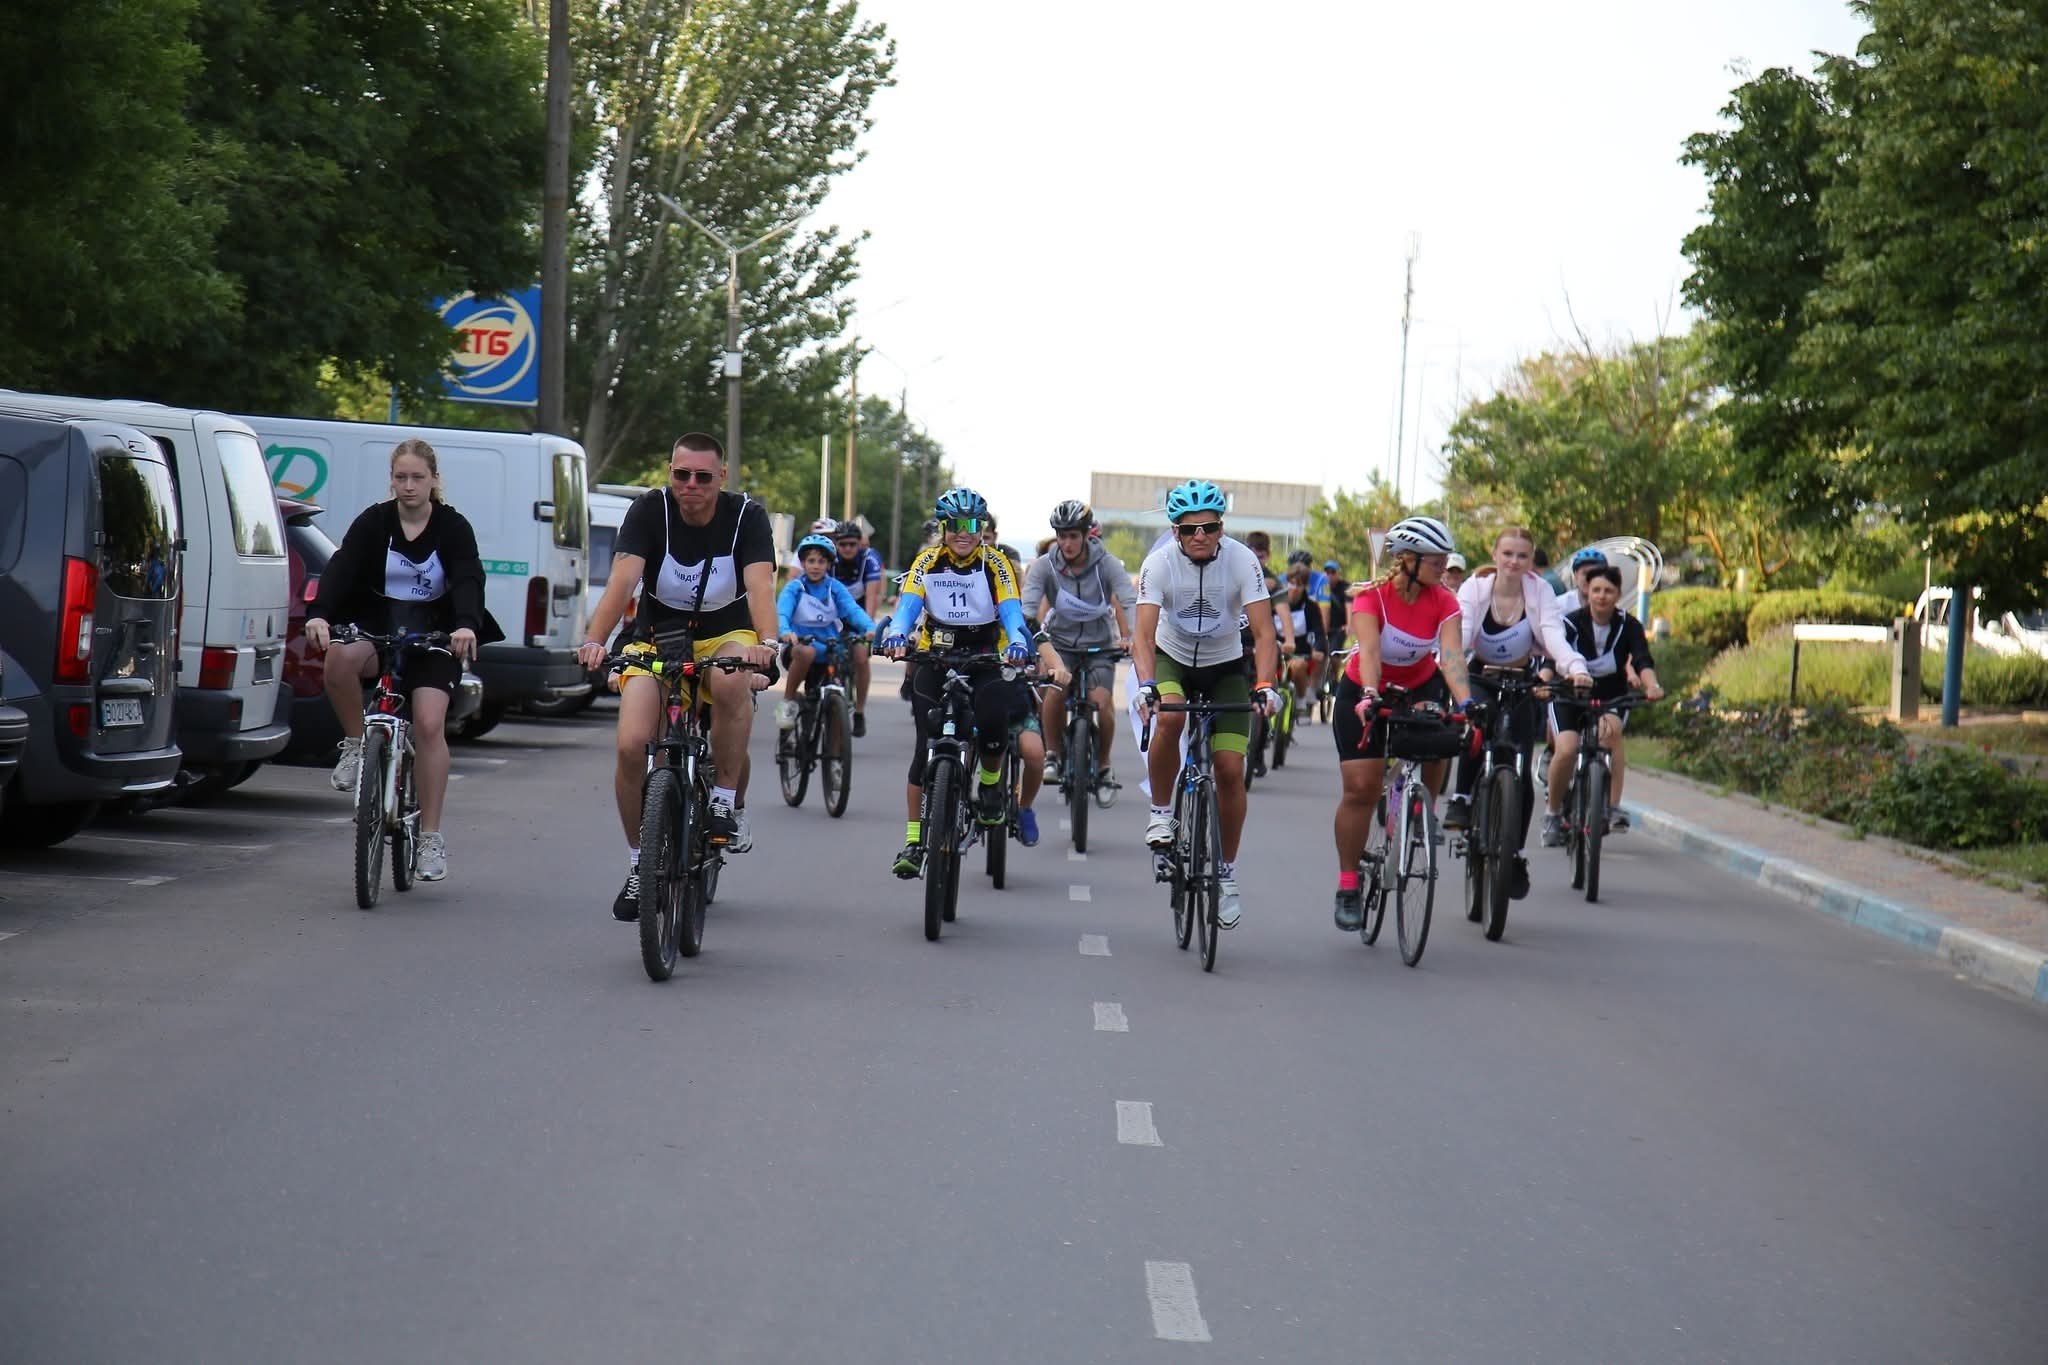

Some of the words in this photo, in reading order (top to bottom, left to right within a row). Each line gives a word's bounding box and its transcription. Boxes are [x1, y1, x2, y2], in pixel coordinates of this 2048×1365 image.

[415, 573, 433, 590] 12
[933, 580, 975, 589] ПІВДЕННИЙ
[949, 592, 967, 607] 11
